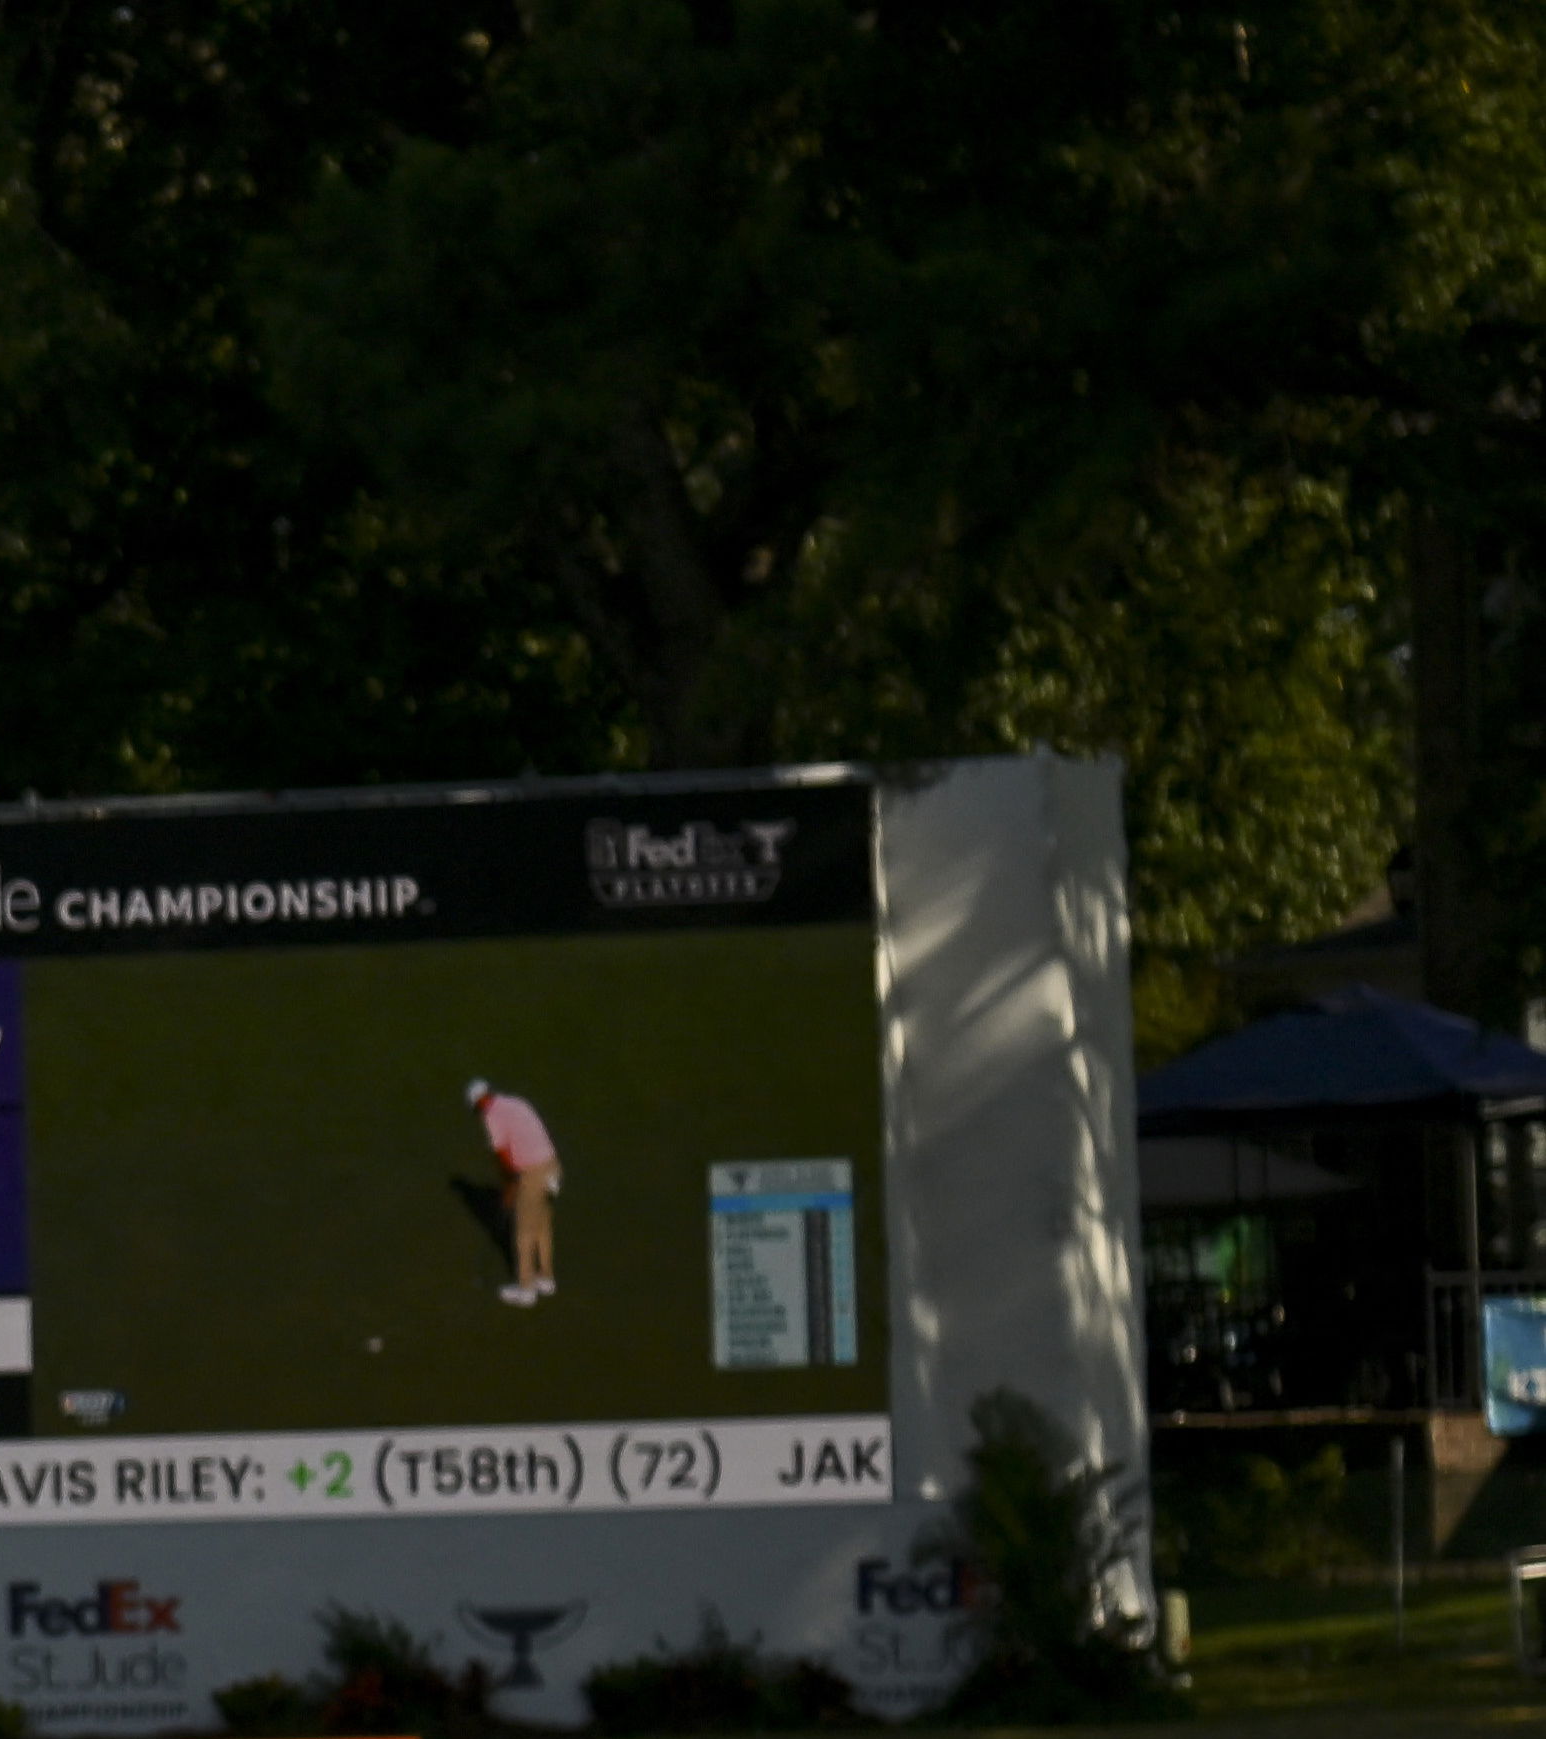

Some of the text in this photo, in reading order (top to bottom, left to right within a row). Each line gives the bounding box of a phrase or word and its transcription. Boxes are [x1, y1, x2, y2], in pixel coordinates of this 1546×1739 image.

[55, 877, 418, 932] CHAMPIONSHIP
[114, 1456, 264, 1501] RILEY:
[287, 1449, 355, 1499] +2
[374, 1433, 584, 1505] (T58th)
[609, 1430, 722, 1501] (72)
[778, 1437, 884, 1486] JAK
[8, 1579, 182, 1638] FedEx
